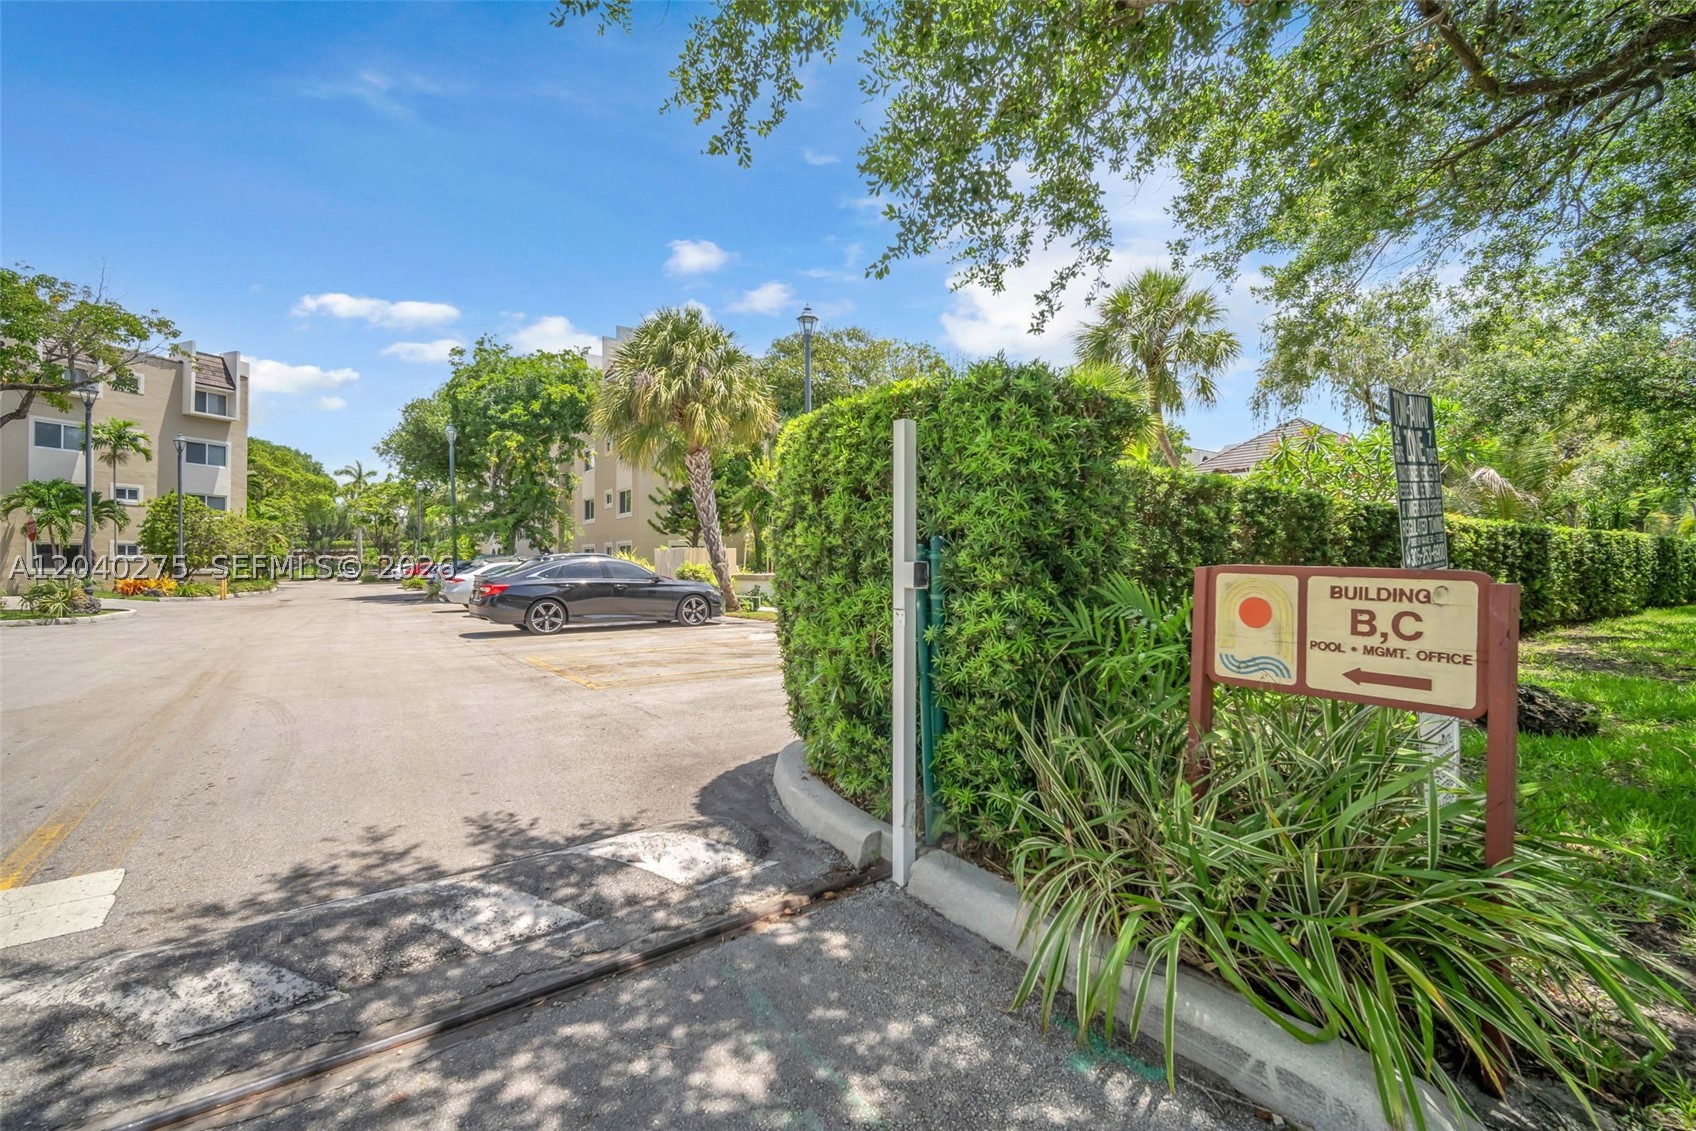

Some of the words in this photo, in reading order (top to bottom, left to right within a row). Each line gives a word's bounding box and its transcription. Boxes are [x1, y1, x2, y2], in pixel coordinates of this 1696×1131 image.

[1330, 585, 1432, 604] BUILDING
[1350, 608, 1424, 644] B,C
[1309, 640, 1346, 653] POOL
[1363, 645, 1410, 660] MGMT.
[1416, 650, 1473, 666] OFFICE
